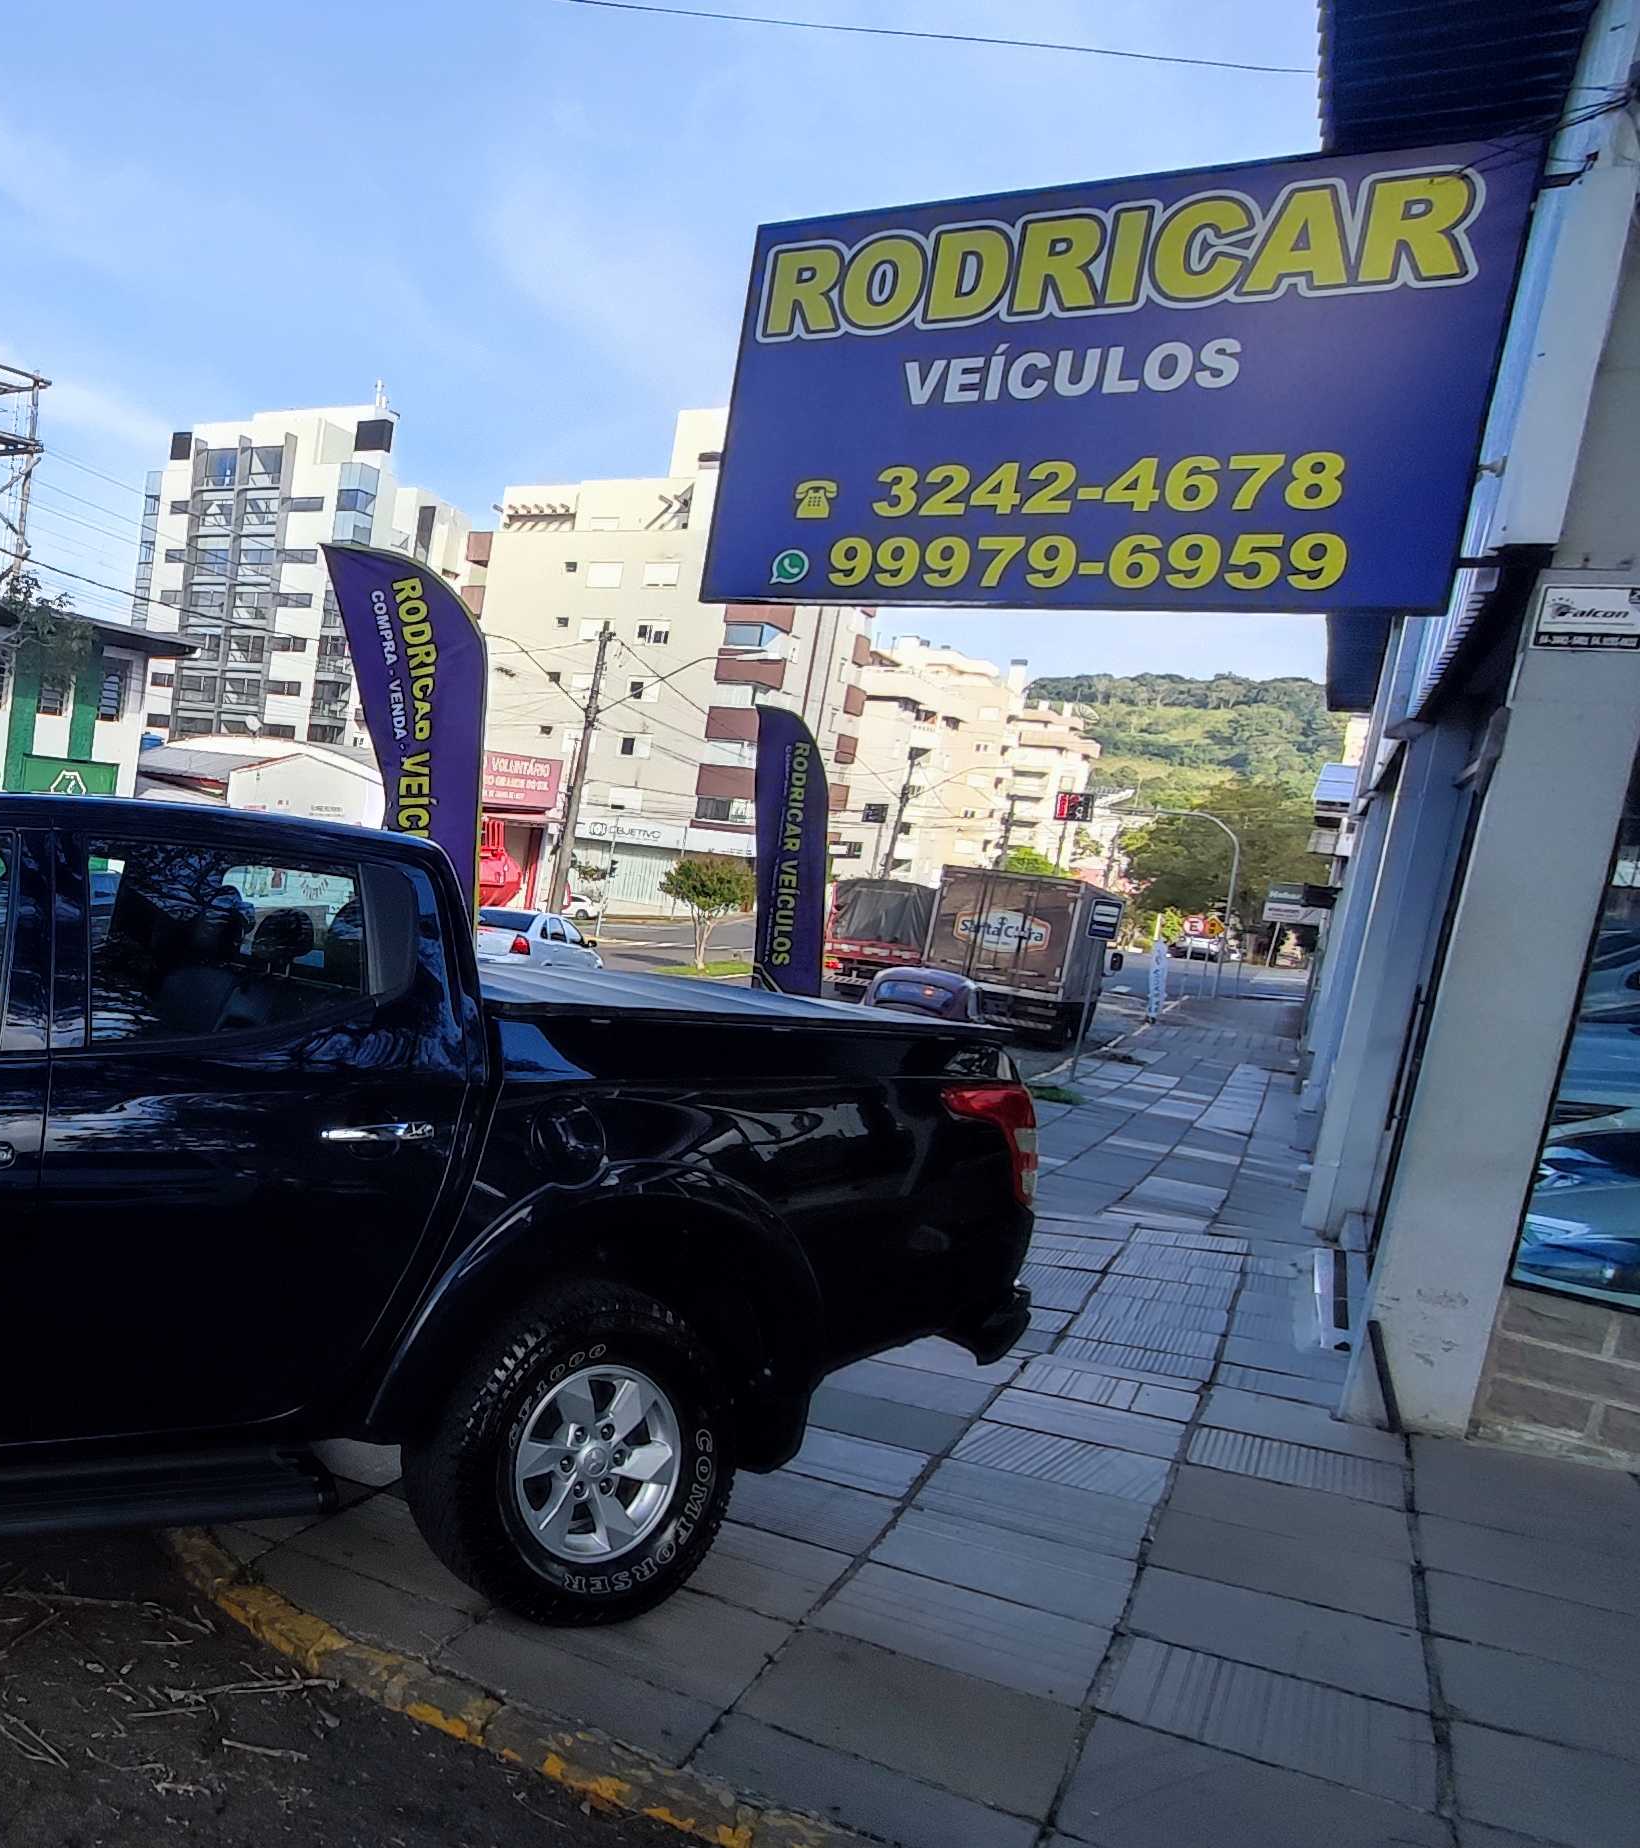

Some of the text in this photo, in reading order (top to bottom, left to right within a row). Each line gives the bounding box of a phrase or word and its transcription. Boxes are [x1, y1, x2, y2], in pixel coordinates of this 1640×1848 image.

[760, 169, 1480, 342] RODRICAR
[903, 339, 1241, 405] VEÍCULOS
[872, 452, 1346, 518] 3242-4678
[828, 533, 1348, 590] 99979-6959
[1554, 603, 1630, 619] Falcon
[370, 590, 398, 666] COMPRA
[387, 678, 408, 741] VENDA
[771, 741, 810, 967] RODRICAR VEÍCULOS
[563, 1428, 713, 1593] COMFORSER
